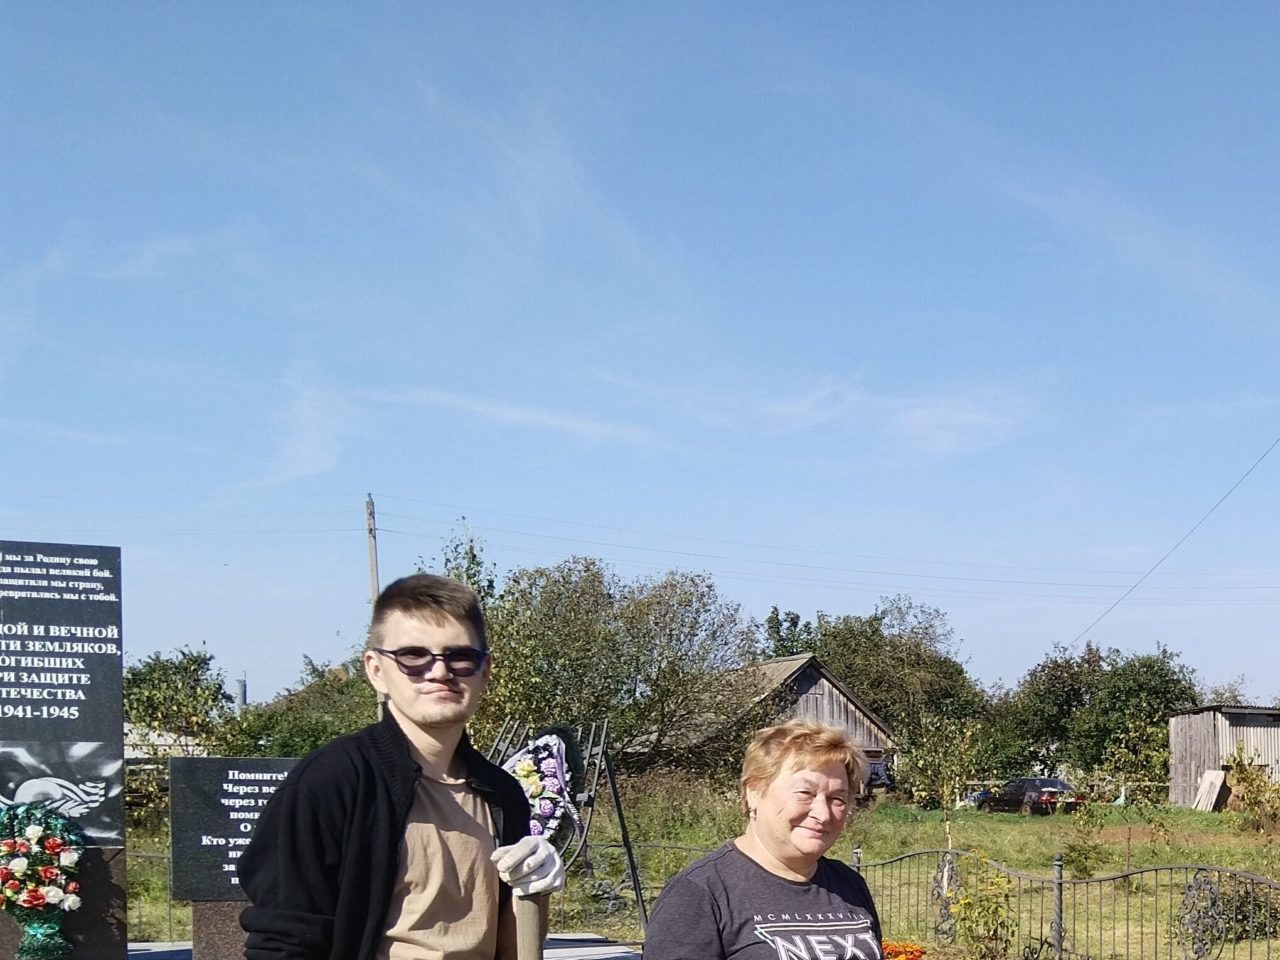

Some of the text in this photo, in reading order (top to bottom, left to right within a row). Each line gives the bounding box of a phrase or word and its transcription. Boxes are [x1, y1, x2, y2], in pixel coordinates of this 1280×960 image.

[5, 554, 21, 562] мы
[36, 554, 71, 566] Родину
[73, 557, 98, 566] свою
[14, 567, 46, 575] пылал
[49, 568, 91, 577] великий
[92, 569, 113, 578] бой.
[51, 580, 67, 588] мы
[69, 582, 104, 591] страну,
[89, 594, 119, 602] тобой.
[0, 622, 119, 638] ОЙ И ВЕЧНОЙ
[25, 641, 121, 656] ЗЕМЛЯКОВ,
[20, 673, 91, 685] ЗАЩИТЕ
[0, 705, 79, 718] 1941-1945
[223, 784, 259, 795] Через
[221, 799, 255, 808] через
[240, 823, 251, 832] О
[201, 836, 226, 845] Кто
